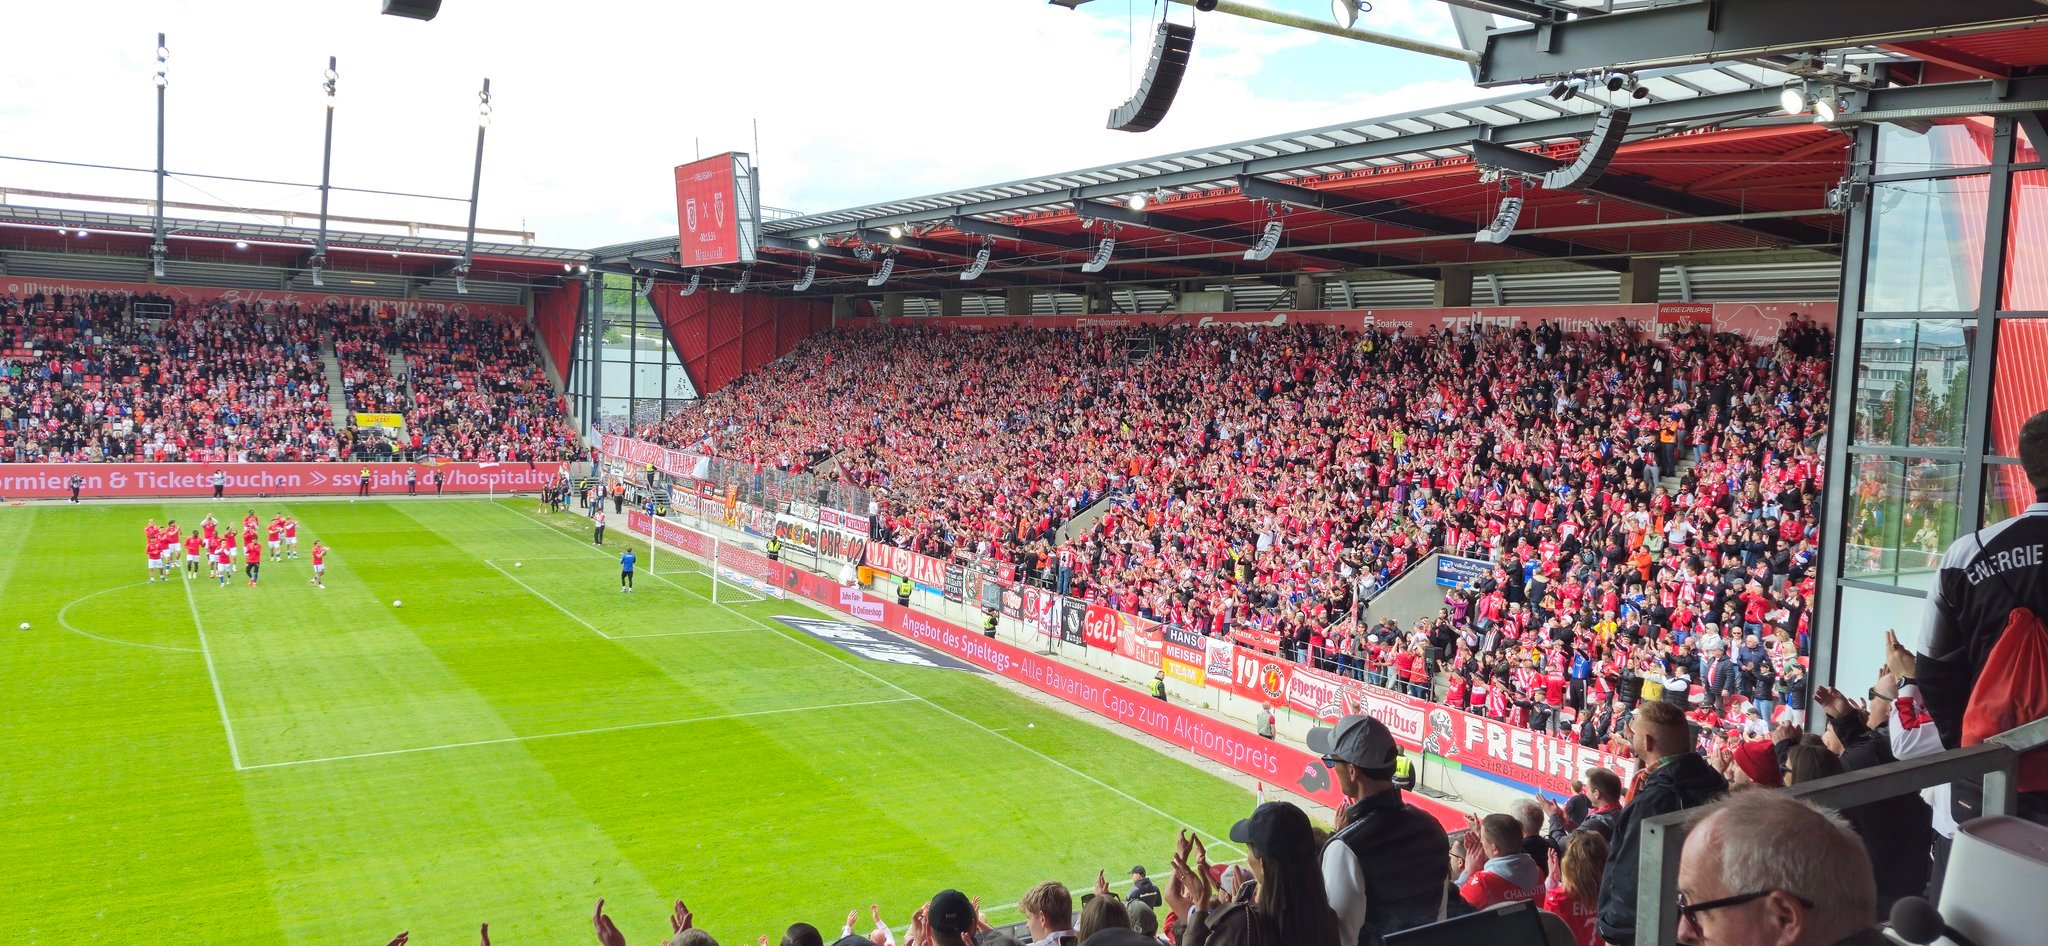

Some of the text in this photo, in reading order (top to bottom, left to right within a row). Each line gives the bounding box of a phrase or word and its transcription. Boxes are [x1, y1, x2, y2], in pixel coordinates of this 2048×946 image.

[1660, 306, 1713, 314] REISEGRUPPE
[1376, 319, 1413, 329] Sparkasse
[109, 471, 128, 489] &
[134, 470, 215, 489] Tickets
[222, 470, 301, 488] buchen
[819, 528, 841, 559] CBR
[847, 536, 864, 565] 02
[1966, 544, 2044, 586] ENERGIE
[842, 591, 861, 601] Jahn Fan-
[857, 606, 881, 619] Onlineshop
[1085, 610, 1117, 643] Geil
[1170, 629, 1197, 647] HANS
[1166, 645, 1203, 666] MEISER
[1169, 662, 1196, 681] TEAM
[1236, 654, 1260, 689] 19
[1263, 663, 1284, 678] ENERGIE
[902, 613, 941, 641] Angebot
[943, 628, 960, 649] des
[961, 635, 1010, 672] Spieltags
[1020, 657, 1043, 682] Alle
[1046, 666, 1098, 702] Bavarian
[1102, 689, 1135, 719] Caps
[1138, 706, 1170, 732] zum
[1173, 715, 1278, 775] Aktionspreis
[1262, 683, 1282, 698] COTTBUS
[1291, 676, 1333, 707] energie
[1480, 757, 1572, 795] STIRBT MIT SICH
